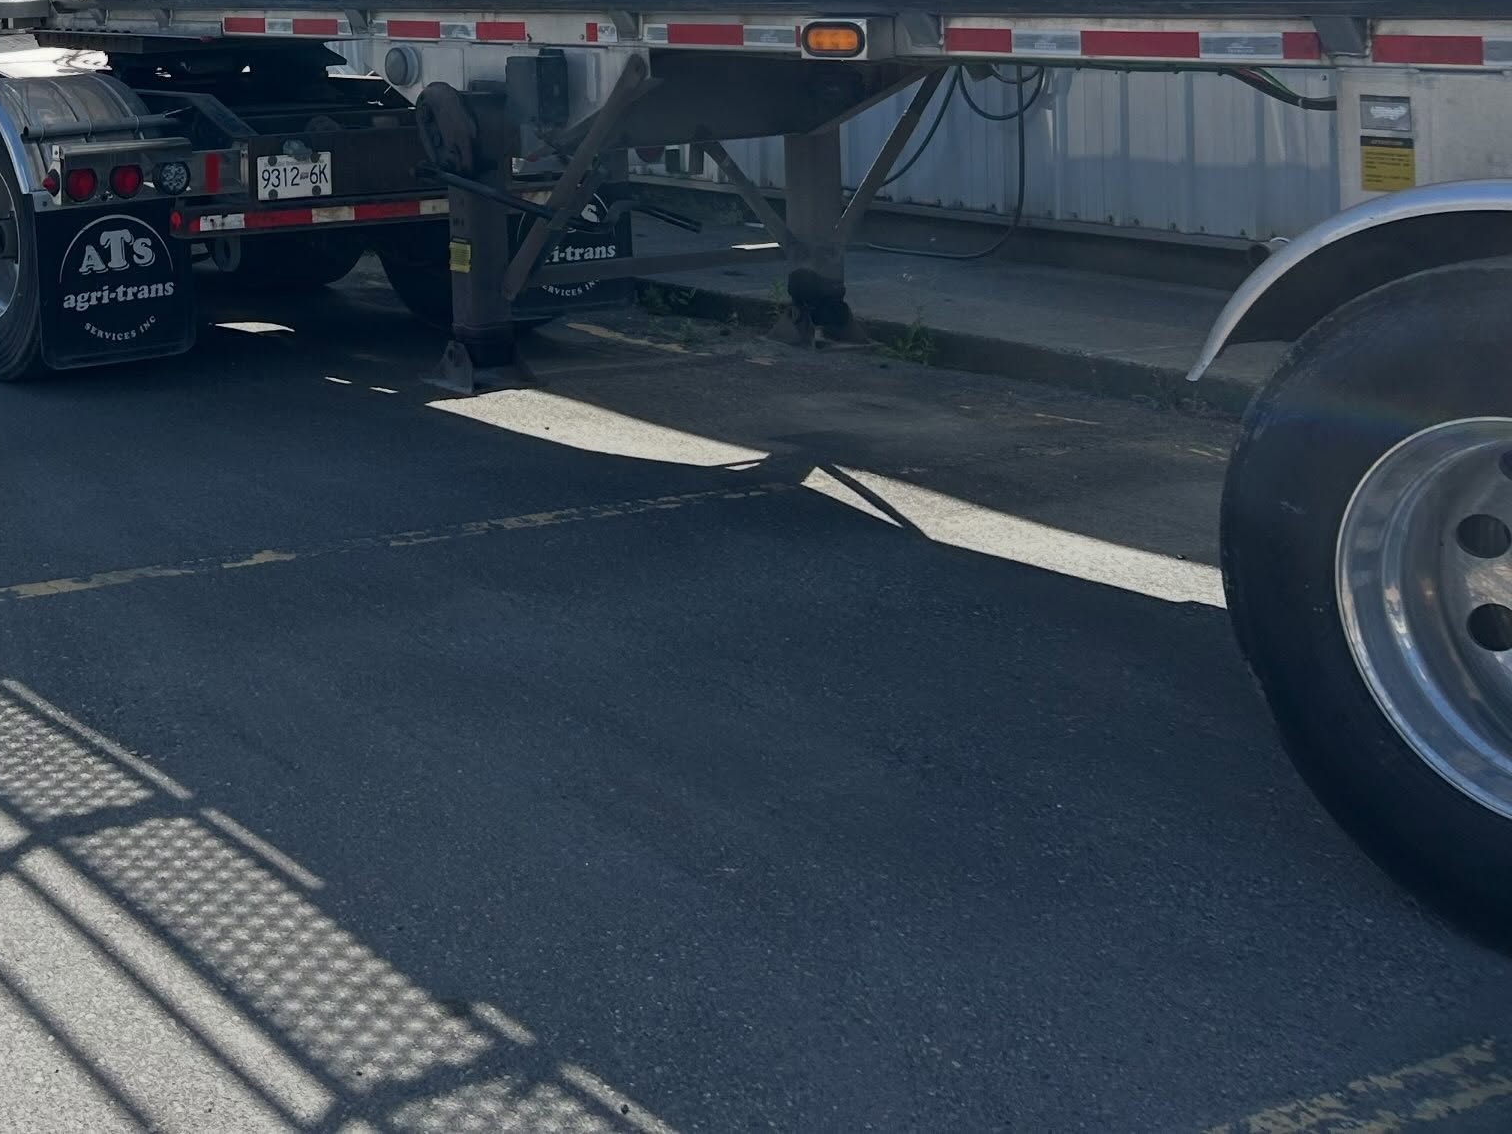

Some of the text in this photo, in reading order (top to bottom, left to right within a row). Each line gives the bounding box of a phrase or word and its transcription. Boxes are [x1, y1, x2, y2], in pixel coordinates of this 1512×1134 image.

[78, 228, 156, 276] ATS
[62, 281, 176, 312] agri-trans
[84, 315, 157, 341] SERVICES INC
